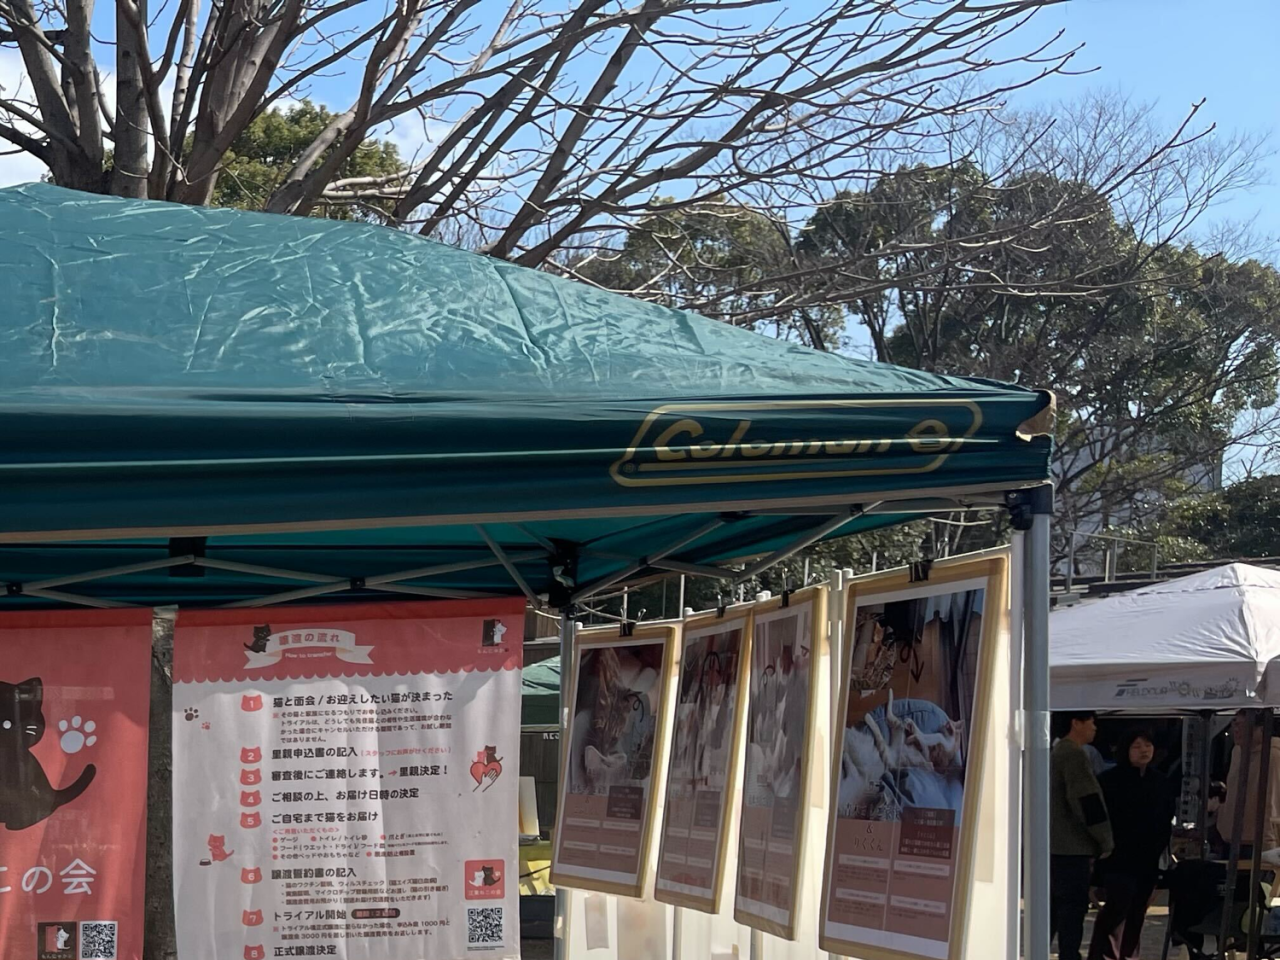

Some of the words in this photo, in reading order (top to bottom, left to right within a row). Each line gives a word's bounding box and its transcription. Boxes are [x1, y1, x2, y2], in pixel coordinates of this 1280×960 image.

[279, 632, 340, 646] 譲渡の流れ
[248, 752, 255, 761] 2
[272, 747, 358, 760] 里親申込書の記入
[247, 774, 255, 782] 3
[271, 768, 385, 782] 審査後にご連絡します。
[247, 796, 255, 804] 4
[271, 788, 420, 803] ご相談の上、お届け日時の決定
[246, 817, 254, 825] 5
[271, 811, 379, 825] ご自宅まで猫をお届け
[248, 872, 255, 880] 6
[273, 910, 347, 921] トライアル開始
[251, 949, 258, 957] 8
[274, 944, 337, 957] 正式譲渡決定
